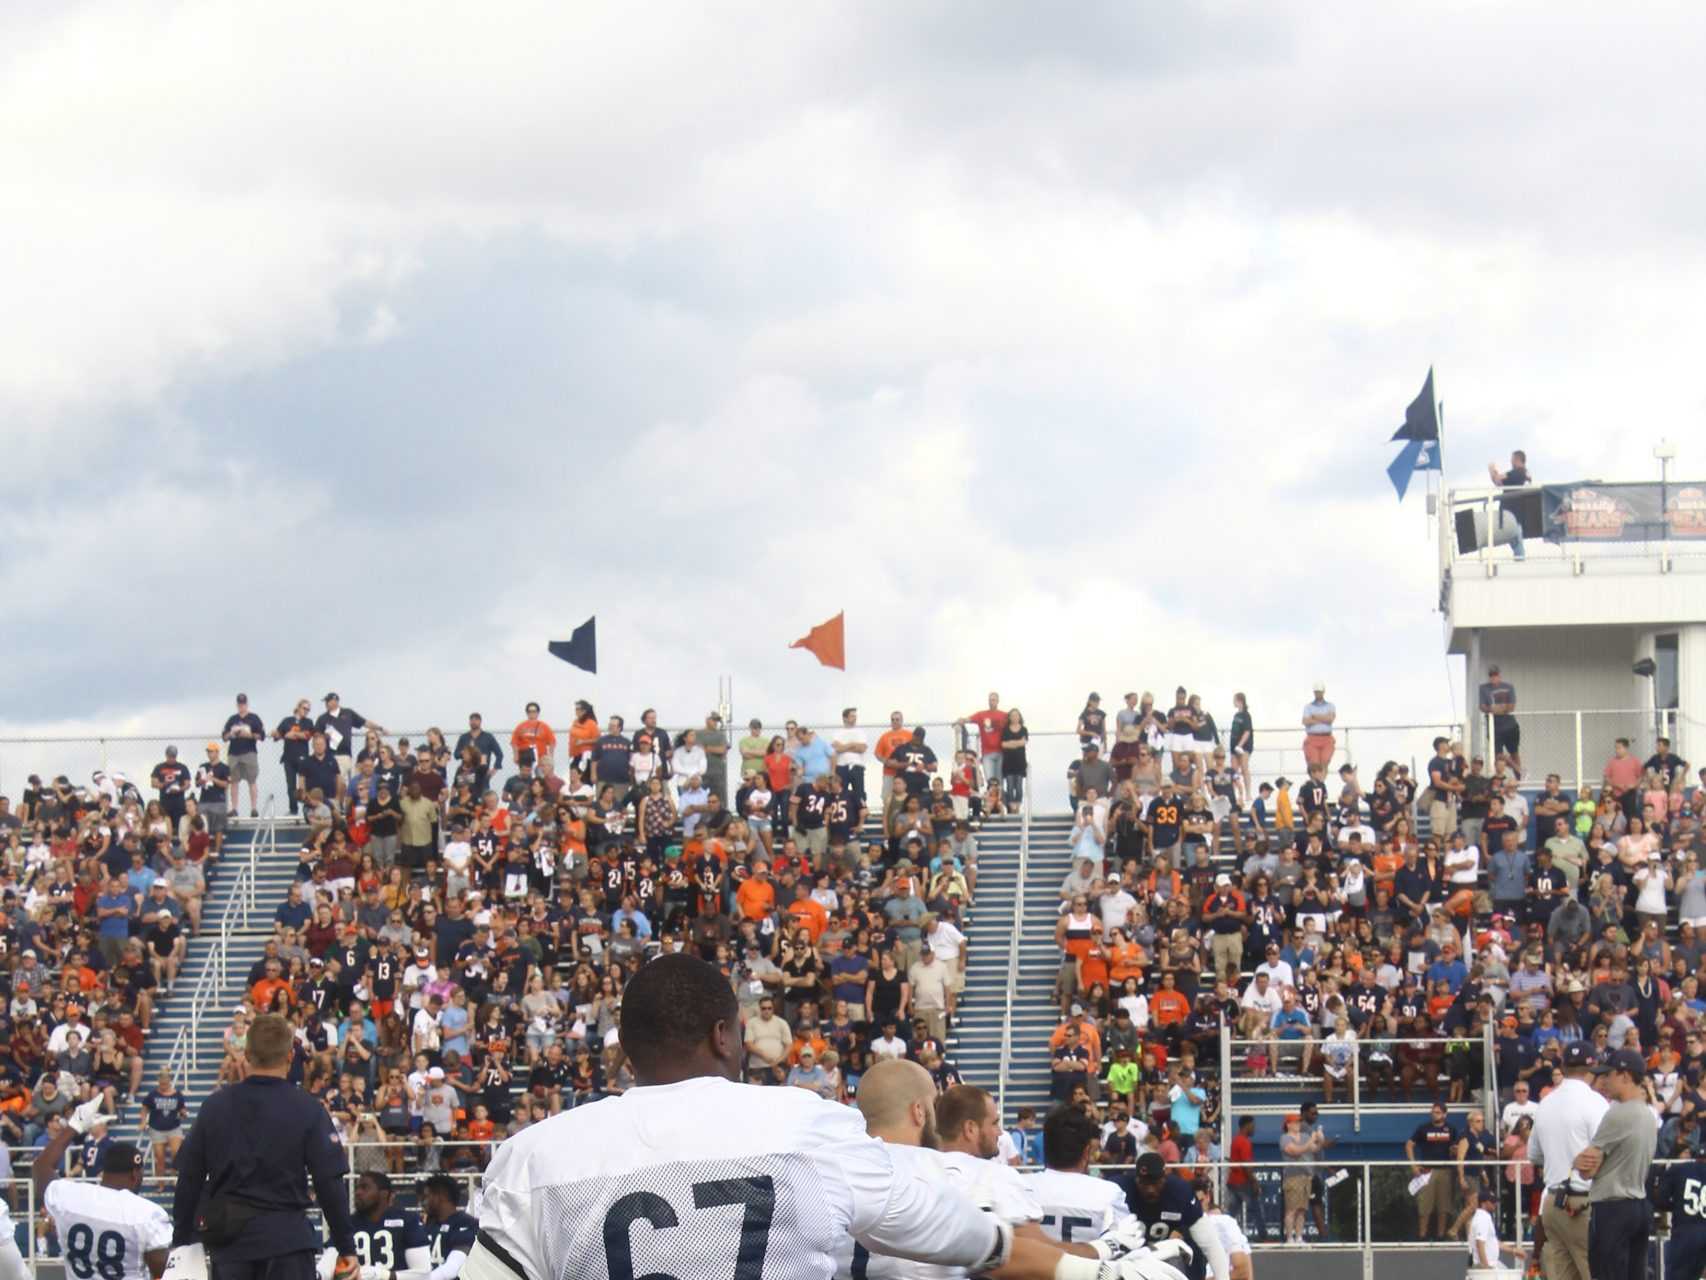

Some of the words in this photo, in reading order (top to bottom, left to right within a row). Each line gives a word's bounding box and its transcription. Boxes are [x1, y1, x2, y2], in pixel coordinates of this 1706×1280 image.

[805, 795, 825, 814] 34
[830, 800, 848, 823] 25
[1156, 806, 1178, 825] 33
[478, 839, 493, 857] 54
[639, 877, 654, 898] 24
[1255, 906, 1273, 925] 34
[346, 950, 356, 967] 6
[378, 962, 391, 980] 13
[1357, 995, 1377, 1013] 54
[353, 1229, 395, 1272] 93
